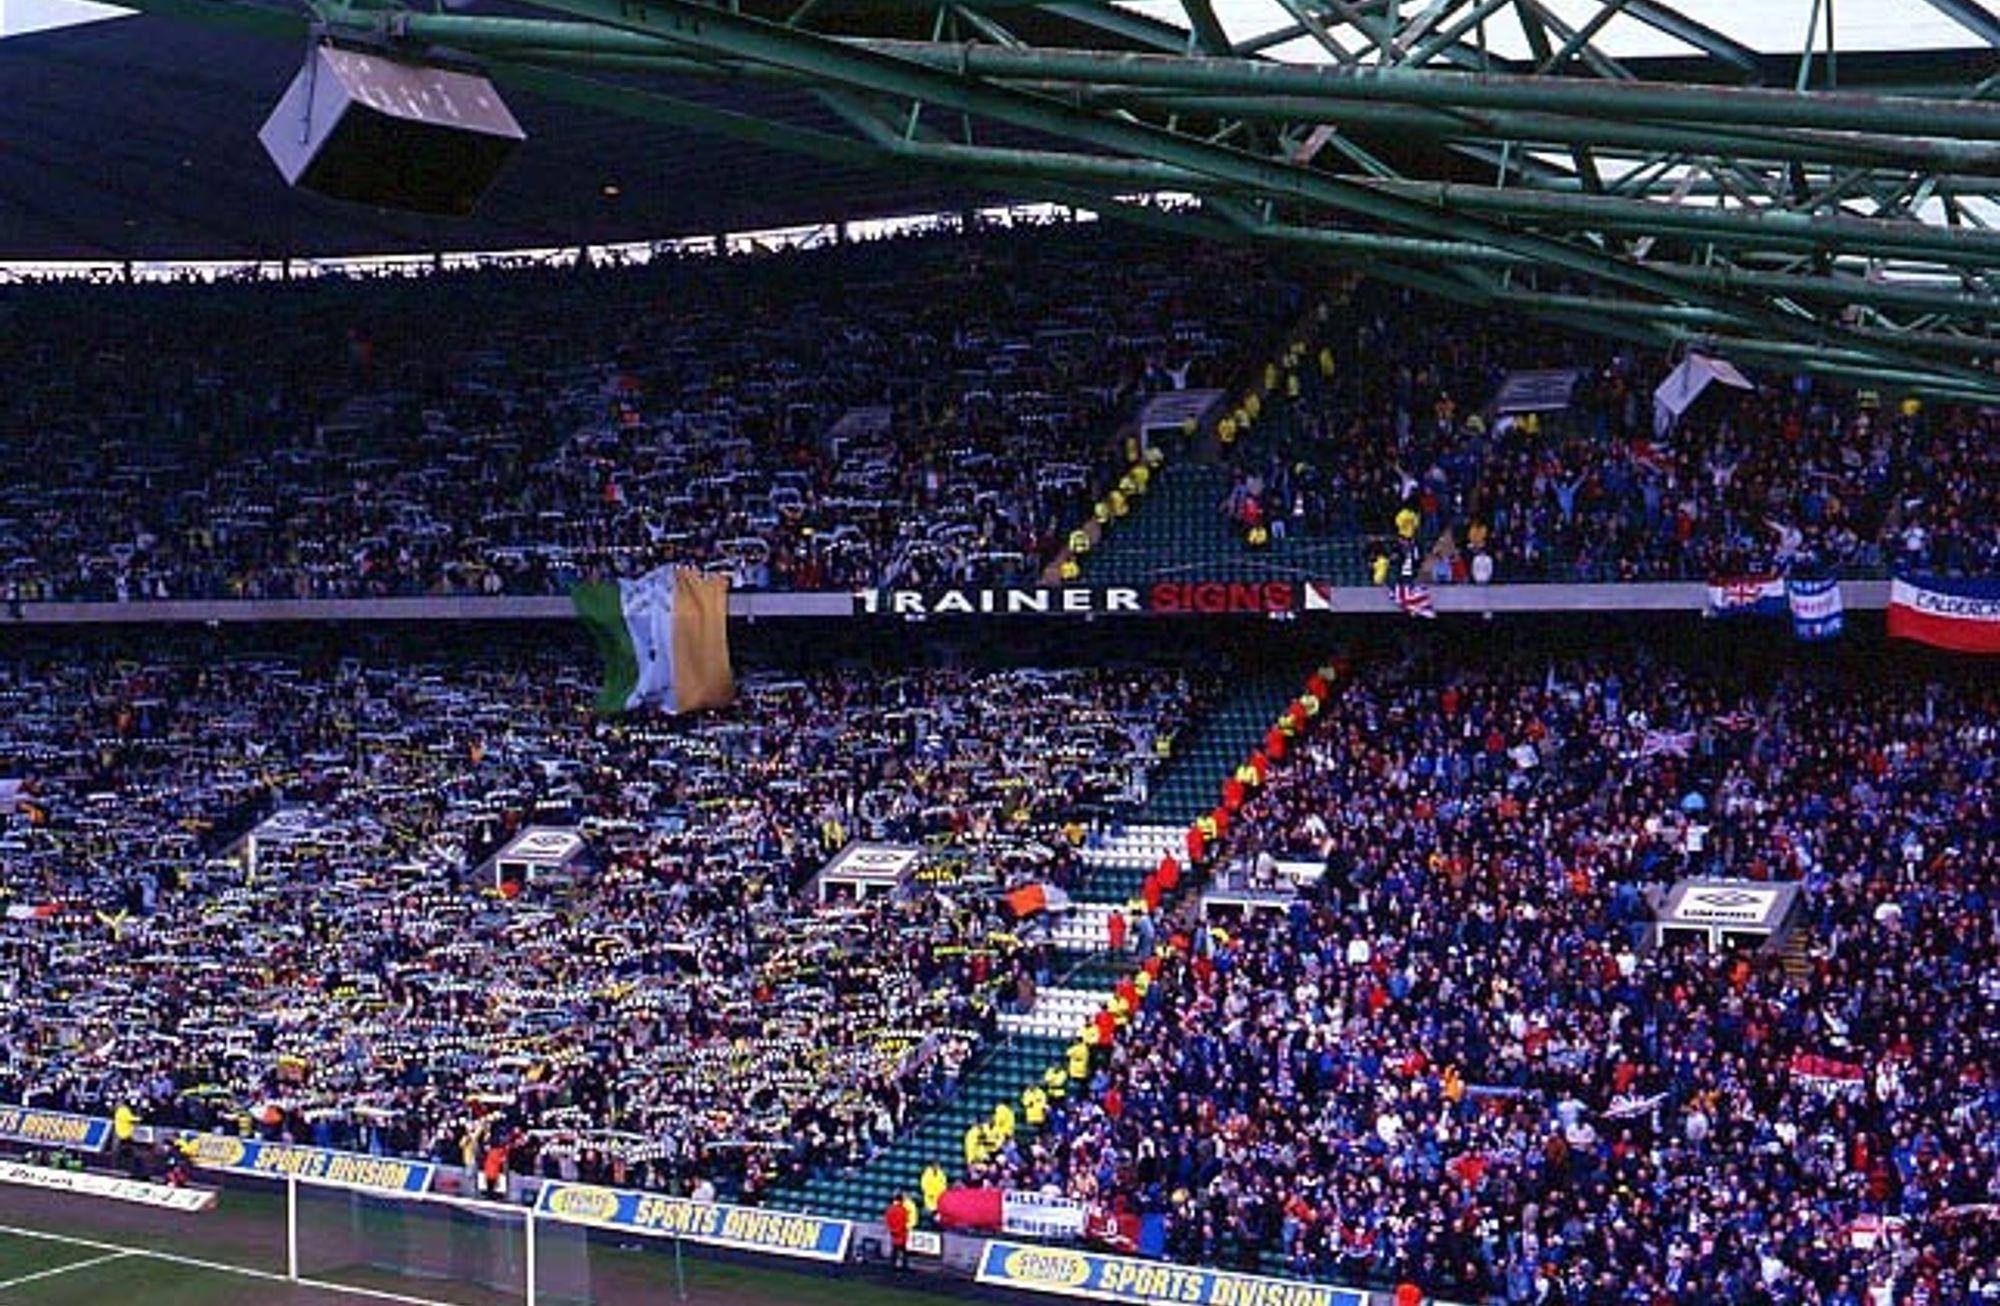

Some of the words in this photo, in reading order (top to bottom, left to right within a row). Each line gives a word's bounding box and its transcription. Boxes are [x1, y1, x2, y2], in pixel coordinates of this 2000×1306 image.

[1152, 582, 1292, 613] SIGNS
[254, 1147, 326, 1177] SPORTS
[325, 1156, 410, 1189] DIVISION
[634, 1199, 719, 1234] SPORTS
[721, 1209, 821, 1248] DIVISION
[1100, 1262, 1203, 1301] SPORTS
[1209, 1275, 1332, 1306] DIVISION
